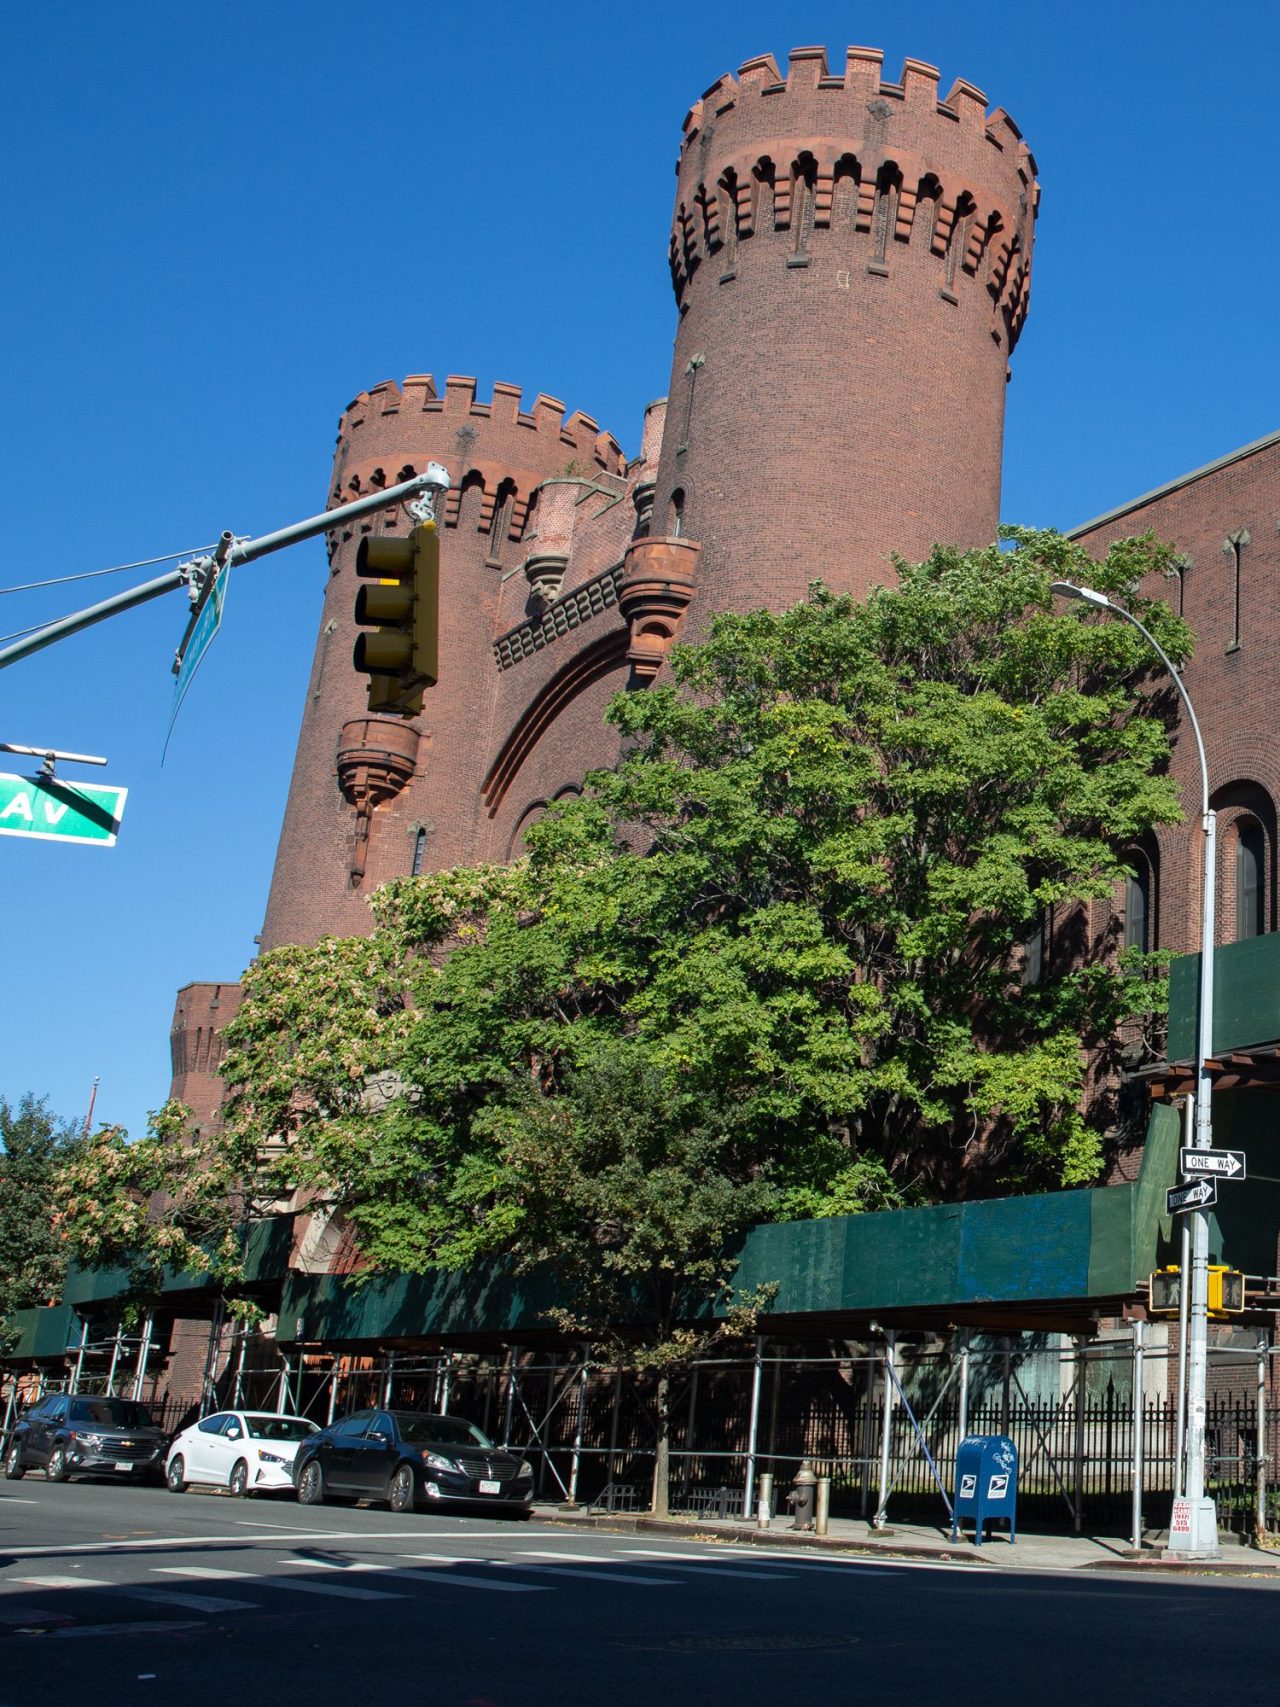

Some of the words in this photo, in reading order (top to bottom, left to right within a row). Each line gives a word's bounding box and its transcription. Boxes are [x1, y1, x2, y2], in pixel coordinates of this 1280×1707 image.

[0, 792, 69, 825] Av
[1191, 1157, 1209, 1168] ONE
[1217, 1159, 1235, 1170] WAY
[1173, 1192, 1187, 1204] ONE
[1193, 1186, 1208, 1199] WAY
